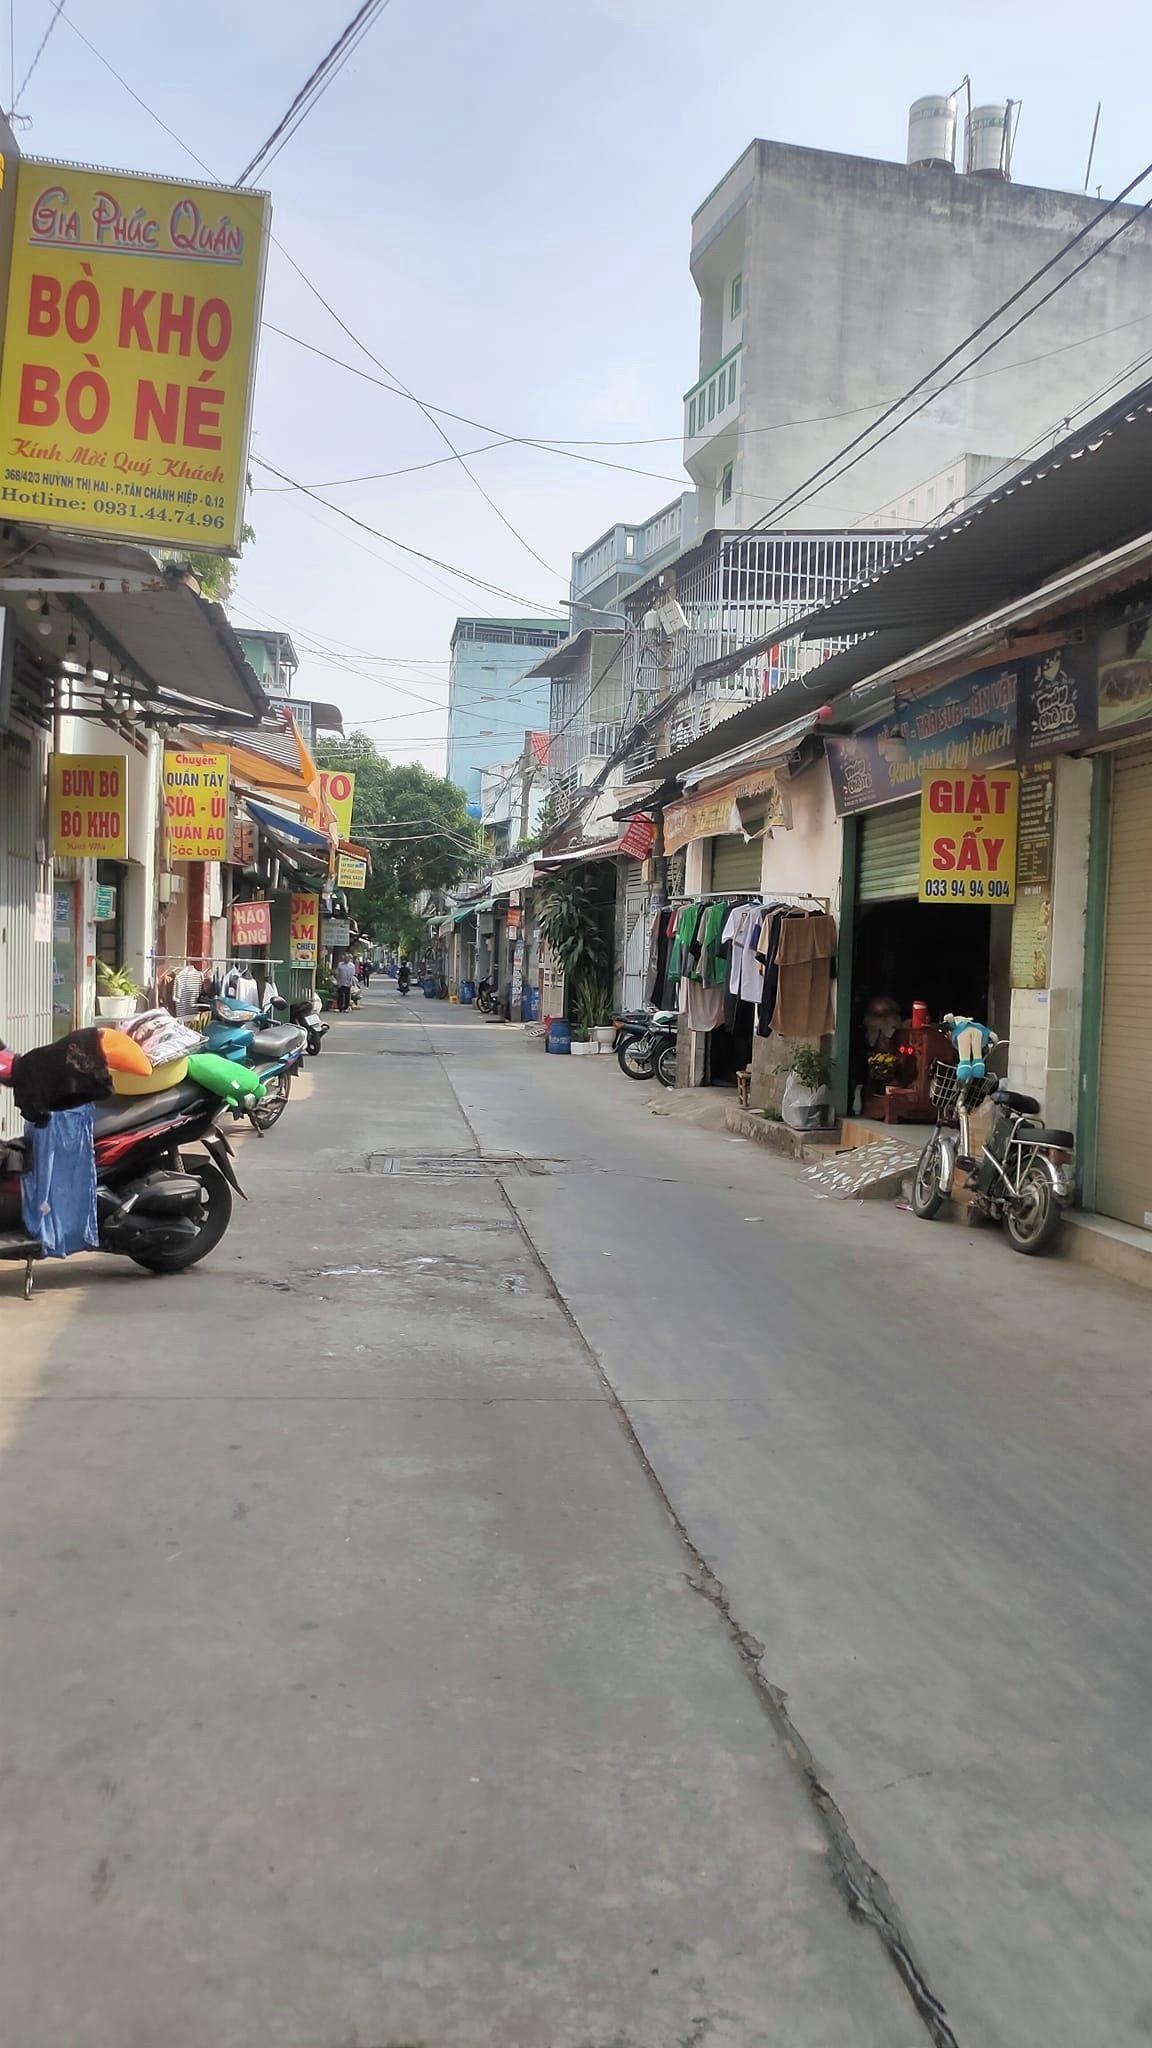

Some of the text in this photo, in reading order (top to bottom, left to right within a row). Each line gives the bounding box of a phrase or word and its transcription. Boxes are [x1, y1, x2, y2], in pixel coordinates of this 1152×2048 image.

[27, 262, 233, 362] BÒ KHO
[18, 353, 226, 451] BÒ NÉ
[7, 438, 225, 484] Kính Mời Quý Khách
[1, 486, 225, 529] Hotline: 0931.44.74.96
[75, 477, 92, 494] THỊ
[93, 479, 109, 493] HAI
[177, 488, 198, 508] HIỆP
[204, 494, 225, 509] Q.12
[62, 763, 120, 797] BÚN BÒ
[167, 789, 196, 818] SỬA
[211, 790, 226, 819] ỦI
[929, 774, 1012, 821] GIẶT
[60, 805, 121, 839] BÒ KHO
[206, 826, 225, 841] ÁO
[197, 844, 221, 861] Loại
[932, 826, 1006, 872] SẤY
[925, 878, 948, 897] 033
[950, 879, 966, 897] 94
[969, 879, 985, 897] 94
[988, 879, 1010, 898] 904
